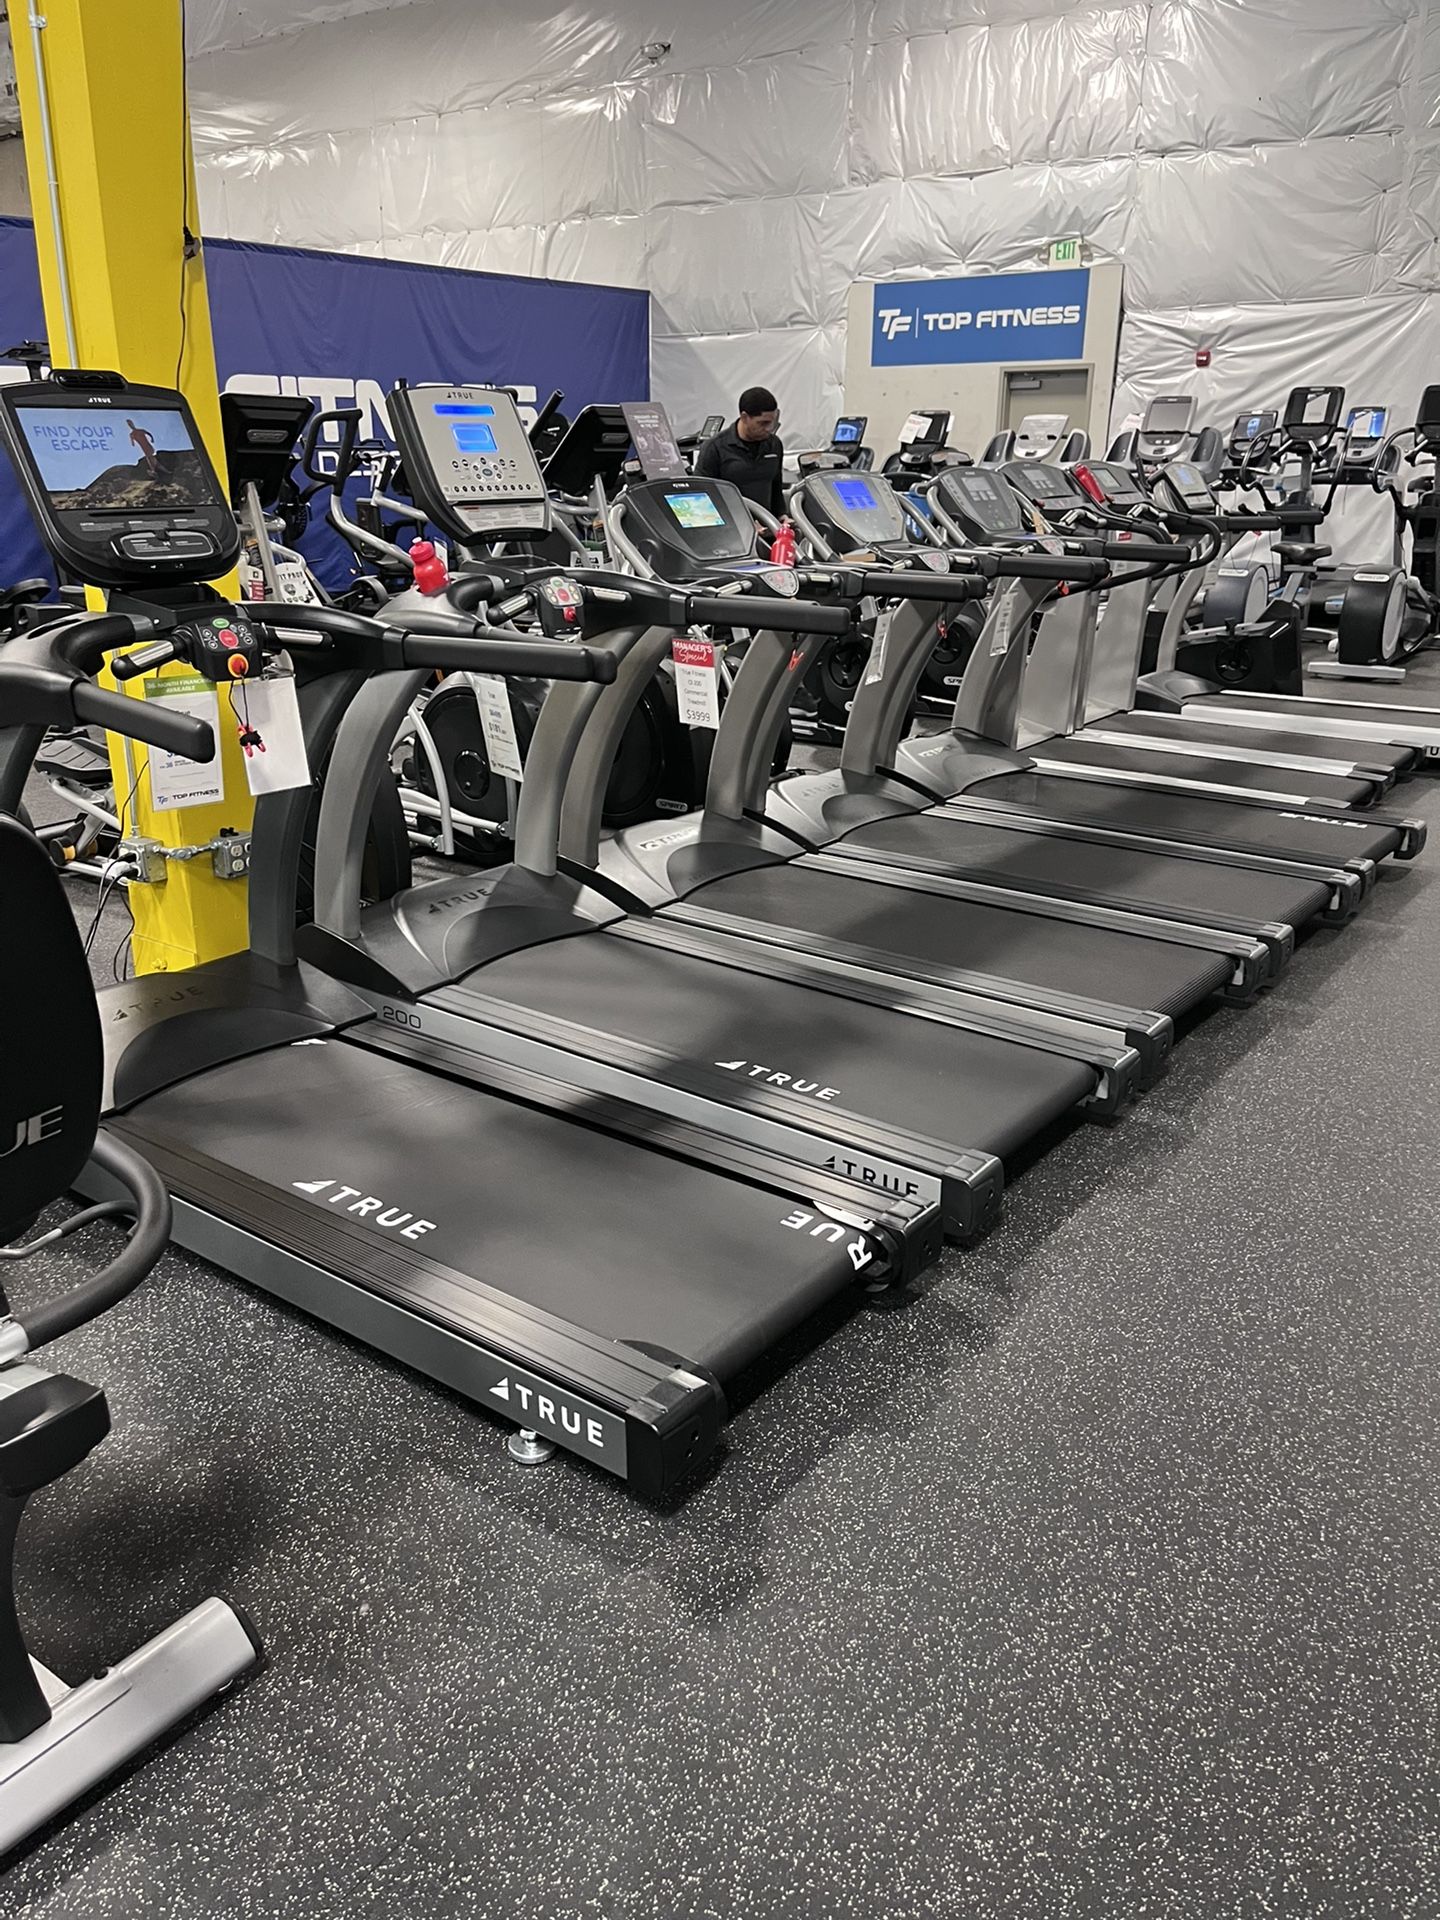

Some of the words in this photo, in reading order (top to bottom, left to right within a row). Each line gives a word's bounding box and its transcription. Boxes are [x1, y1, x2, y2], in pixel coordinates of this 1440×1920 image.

[1055, 241, 1077, 261] EXIT
[923, 311, 972, 331] TOP
[976, 305, 1080, 329] FITNESS
[33, 426, 69, 438] FIND
[72, 426, 114, 437] YOUR
[172, 792, 188, 800] TOP
[189, 788, 219, 798] FITNESS
[438, 888, 492, 908] TRUE
[129, 985, 204, 1011] TRUE
[383, 1005, 422, 1029] 200
[748, 1064, 841, 1101] TRUE
[328, 1185, 438, 1240] TRUE
[514, 1383, 604, 1448] TRUE
